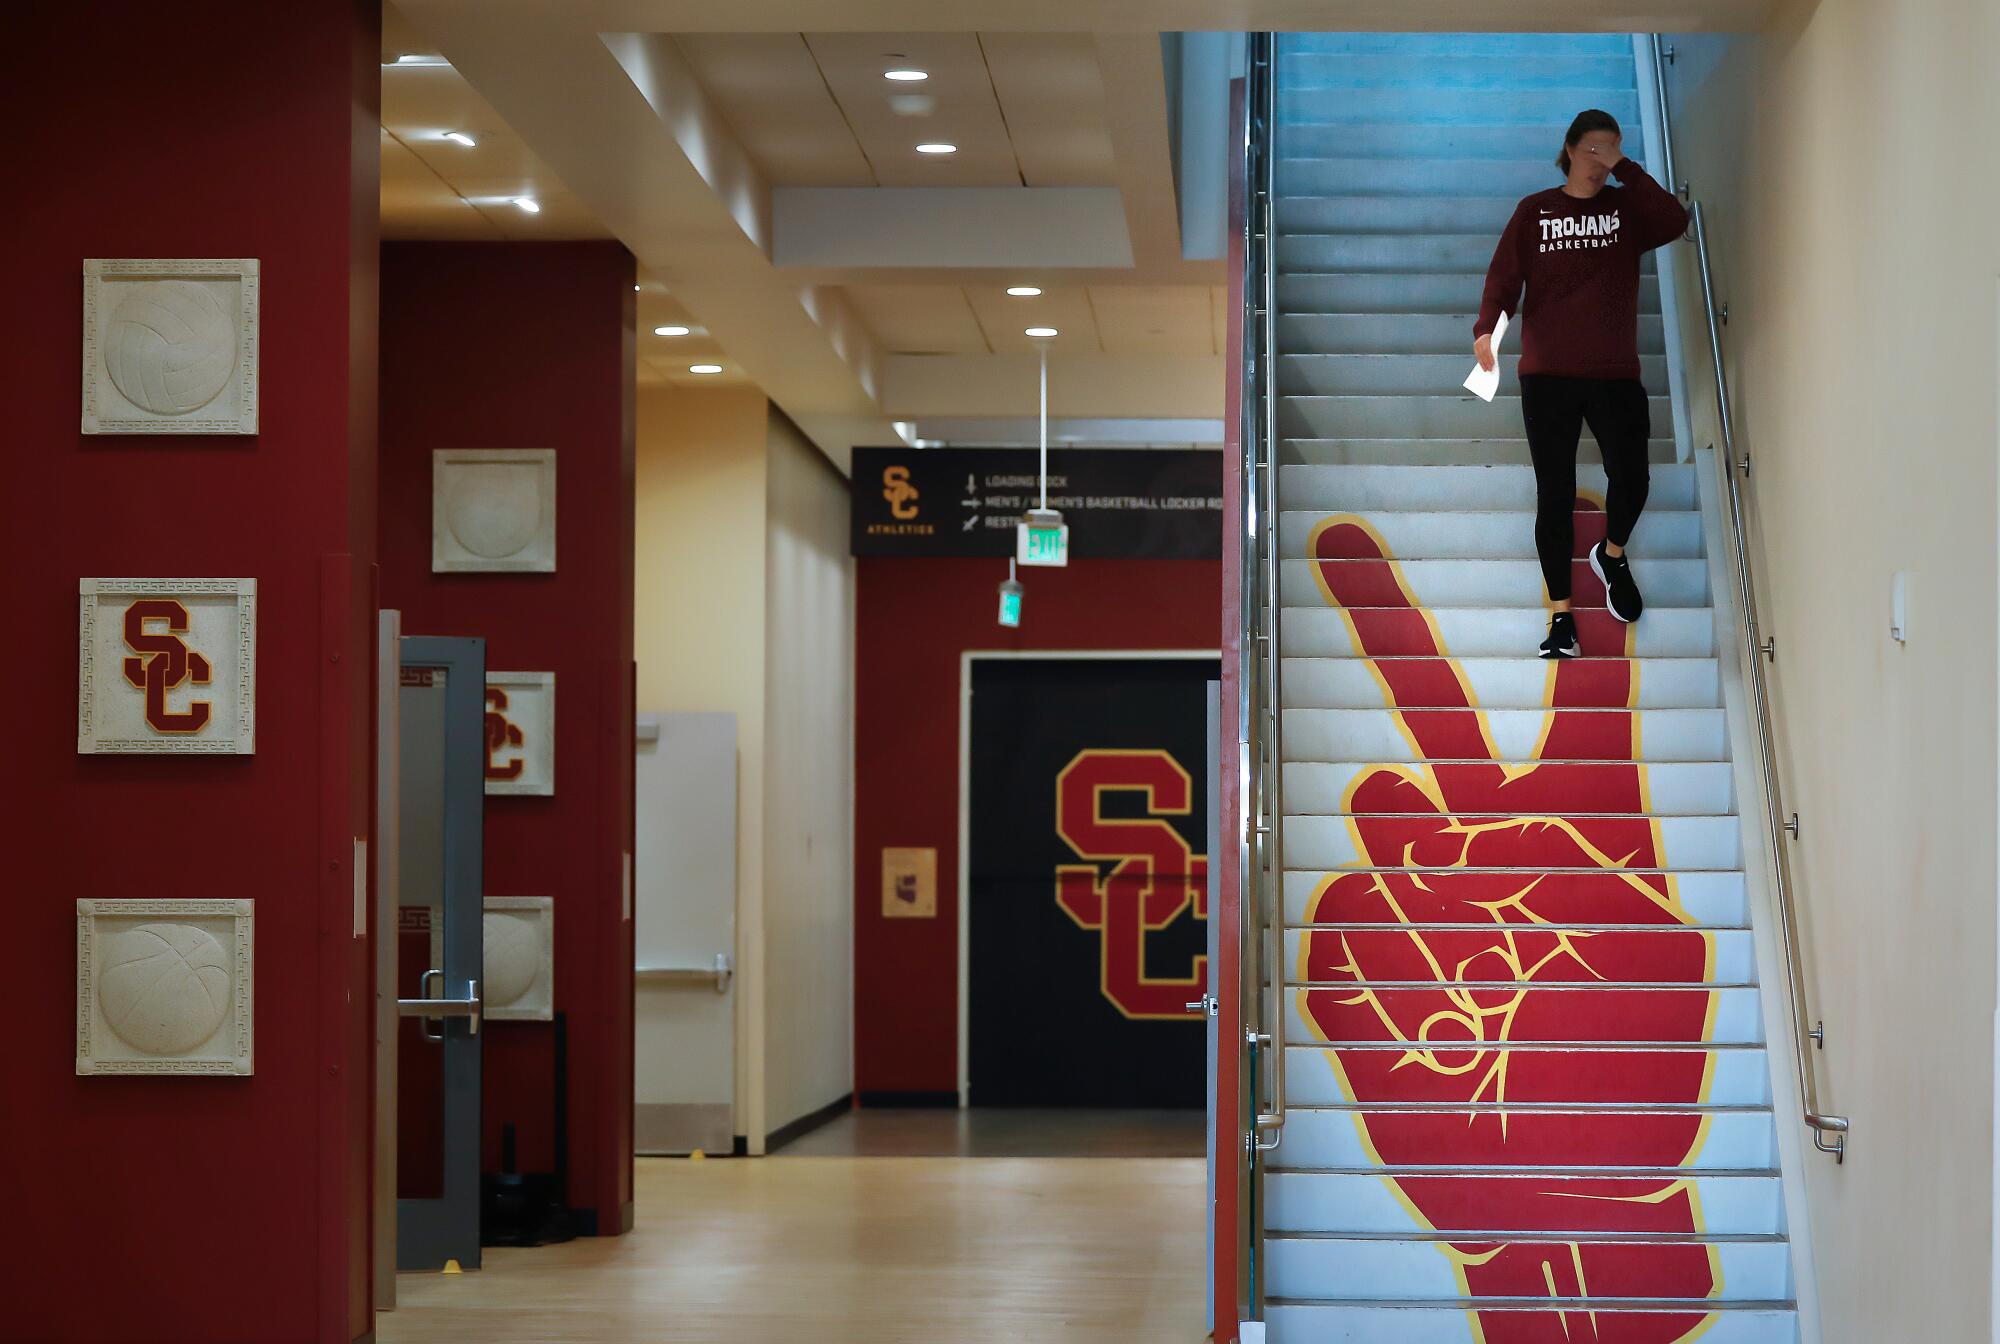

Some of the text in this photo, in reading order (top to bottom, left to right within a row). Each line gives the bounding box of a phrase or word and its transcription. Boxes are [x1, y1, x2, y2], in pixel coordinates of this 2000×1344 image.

[1539, 209, 1620, 240] TROJANS
[883, 466, 919, 519] SC
[985, 476, 1034, 487] LOADING
[985, 496, 1020, 508] MEN'S
[1031, 497, 1083, 509] WMEN'S
[1086, 497, 1158, 509] BASKETBALL
[1161, 498, 1205, 510] LOCKER
[867, 525, 935, 535] ATHLETICS
[1028, 528, 1062, 560] EXIT
[122, 600, 213, 734] SC
